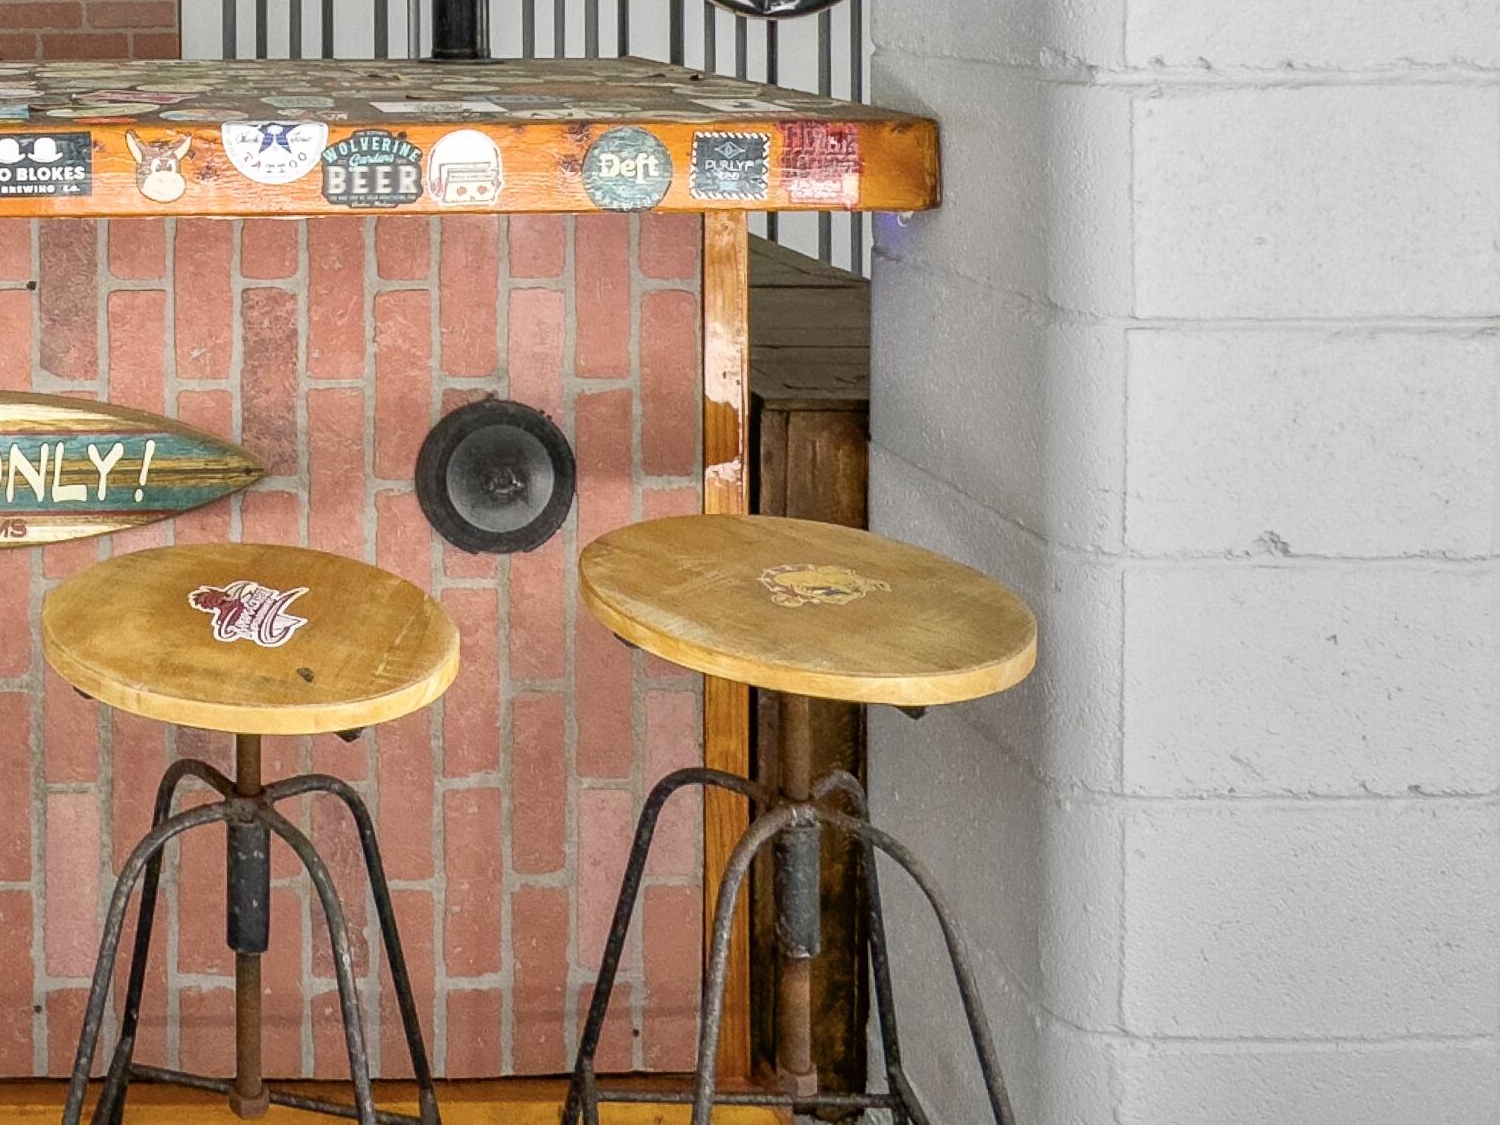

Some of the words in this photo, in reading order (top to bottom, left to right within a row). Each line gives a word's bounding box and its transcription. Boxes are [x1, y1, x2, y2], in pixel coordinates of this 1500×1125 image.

[322, 136, 423, 163] WOLVERINE
[16, 166, 86, 182] BLOKES
[326, 165, 418, 194] BEER
[598, 152, 661, 185] Deft
